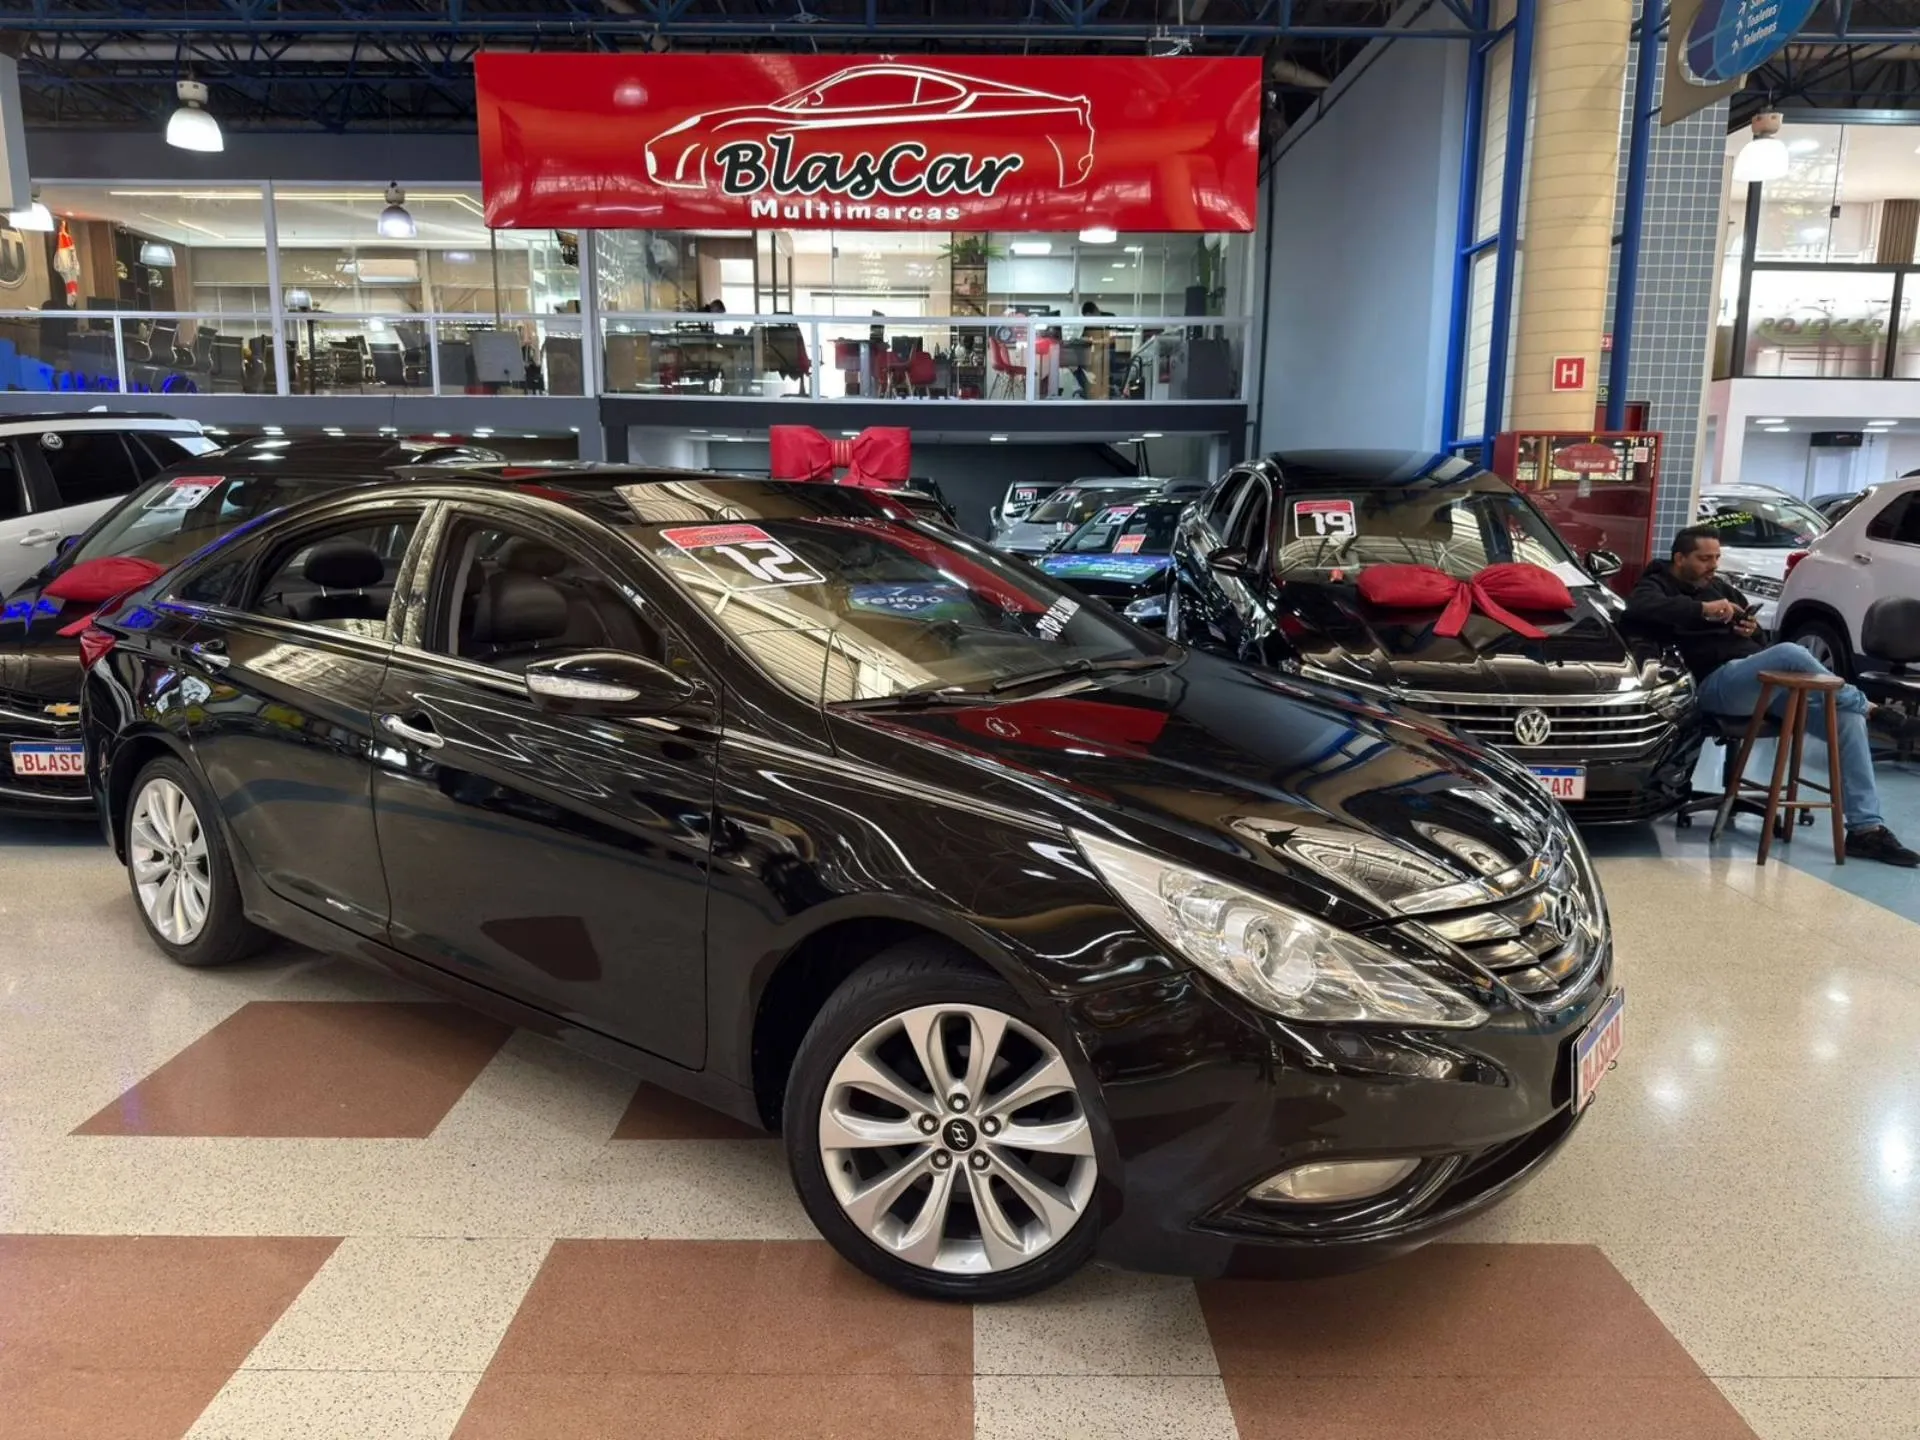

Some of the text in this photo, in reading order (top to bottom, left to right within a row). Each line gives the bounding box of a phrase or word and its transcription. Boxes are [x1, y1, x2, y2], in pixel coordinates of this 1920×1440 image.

[715, 134, 1023, 198] BlasCar
[751, 200, 960, 220] Multimarcas
[1561, 364, 1577, 384] H
[1630, 437, 1656, 447] H 19
[1311, 512, 1353, 535] 19
[714, 542, 816, 583] 12
[22, 754, 82, 771] BLASC
